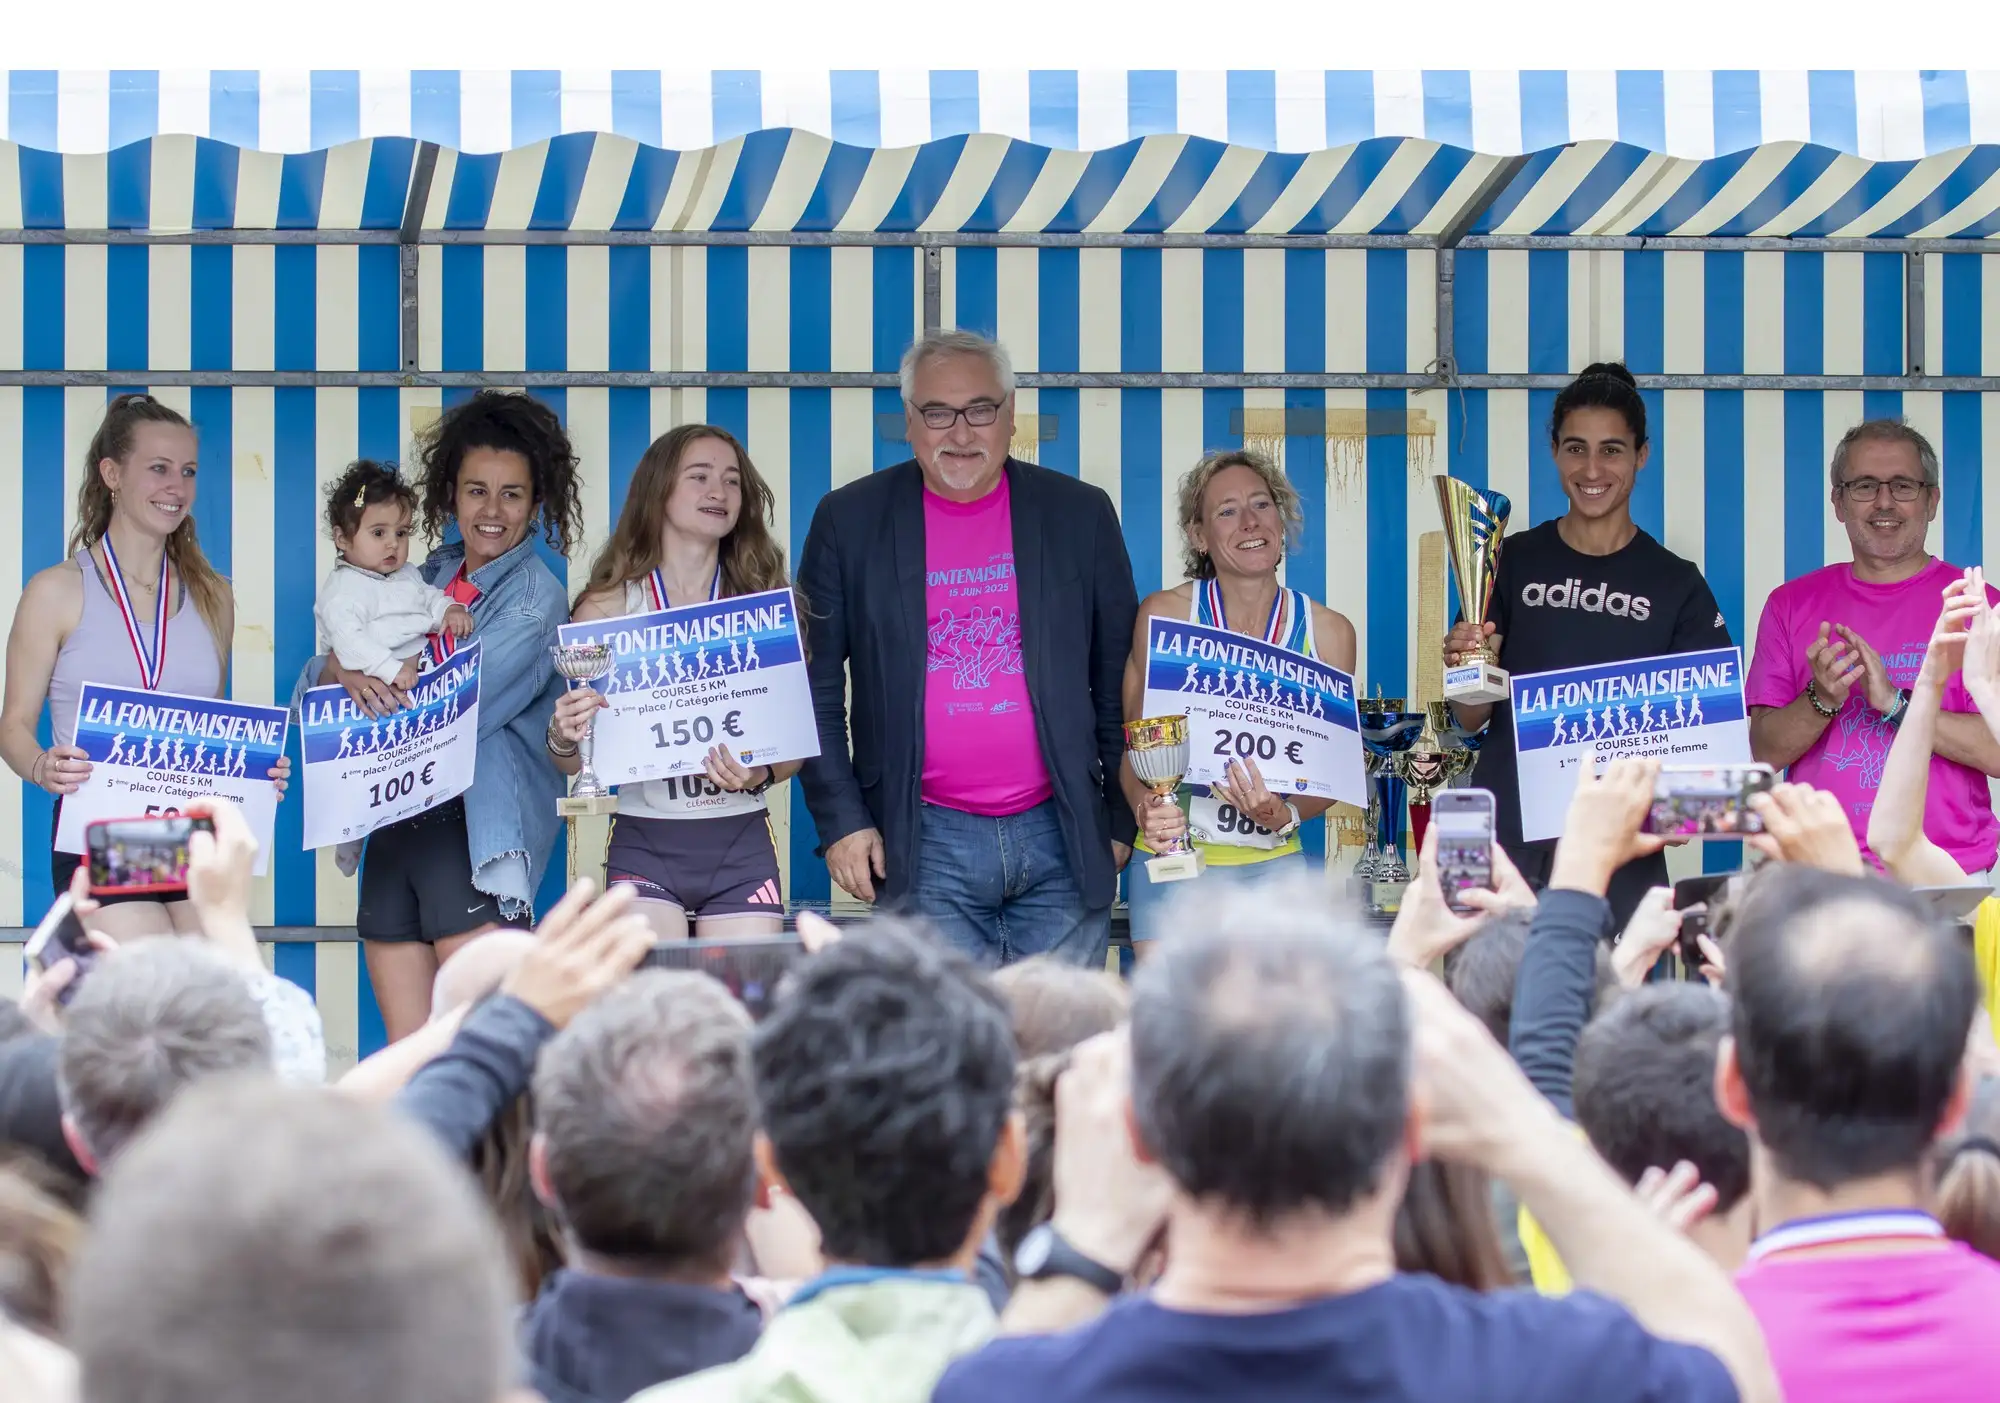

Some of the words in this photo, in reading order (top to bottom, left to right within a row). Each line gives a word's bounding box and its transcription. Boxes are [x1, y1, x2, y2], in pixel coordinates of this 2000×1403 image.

[949, 589, 958, 597] 15
[960, 586, 982, 597] JUIN
[984, 583, 1009, 593] 2025
[1522, 578, 1651, 621] adidas
[1156, 631, 1182, 656] LA
[1186, 635, 1349, 702] FONTENAISIENNE
[308, 700, 334, 727] LA
[338, 652, 479, 722] FONAISIENNE
[638, 701, 666, 715] place
[668, 699, 673, 709] /
[676, 693, 729, 709] Catégorie
[731, 685, 769, 700] femme
[652, 684, 699, 700] COURSE
[701, 682, 707, 692] 5
[709, 680, 727, 691] KM
[1520, 688, 1547, 714] LA
[1552, 662, 1734, 710] FONTENAISIENNE
[84, 698, 111, 725] LA
[115, 702, 282, 746] FONTENAISIENNE
[1184, 706, 1191, 715] 2
[1208, 709, 1236, 721] place
[1238, 712, 1243, 721] /
[1245, 713, 1294, 731] Catégorie
[1296, 724, 1330, 742] femme
[1225, 699, 1269, 715] COURSE
[1270, 708, 1276, 716] 5
[1278, 710, 1294, 721] KM
[650, 715, 714, 748] 150
[721, 710, 745, 737] €
[1595, 737, 1641, 751] COURSE
[1643, 736, 1649, 745] 5
[1651, 734, 1669, 745] KM
[363, 765, 387, 779] place
[388, 761, 393, 770] /
[394, 746, 431, 768] Catégorie
[433, 734, 458, 751] femme
[377, 745, 412, 762] COURSE
[412, 742, 418, 750] 5
[419, 735, 433, 747] KM
[1213, 729, 1276, 760] 200
[1284, 741, 1304, 765] €
[1671, 743, 1708, 754] femme
[129, 782, 156, 793] place
[158, 784, 163, 794] /
[147, 771, 188, 785] COURSE
[190, 777, 195, 785] 5
[197, 778, 213, 787] KM
[369, 770, 414, 808] 100
[419, 761, 436, 785] €
[686, 797, 727, 808] CLÉMENCE
